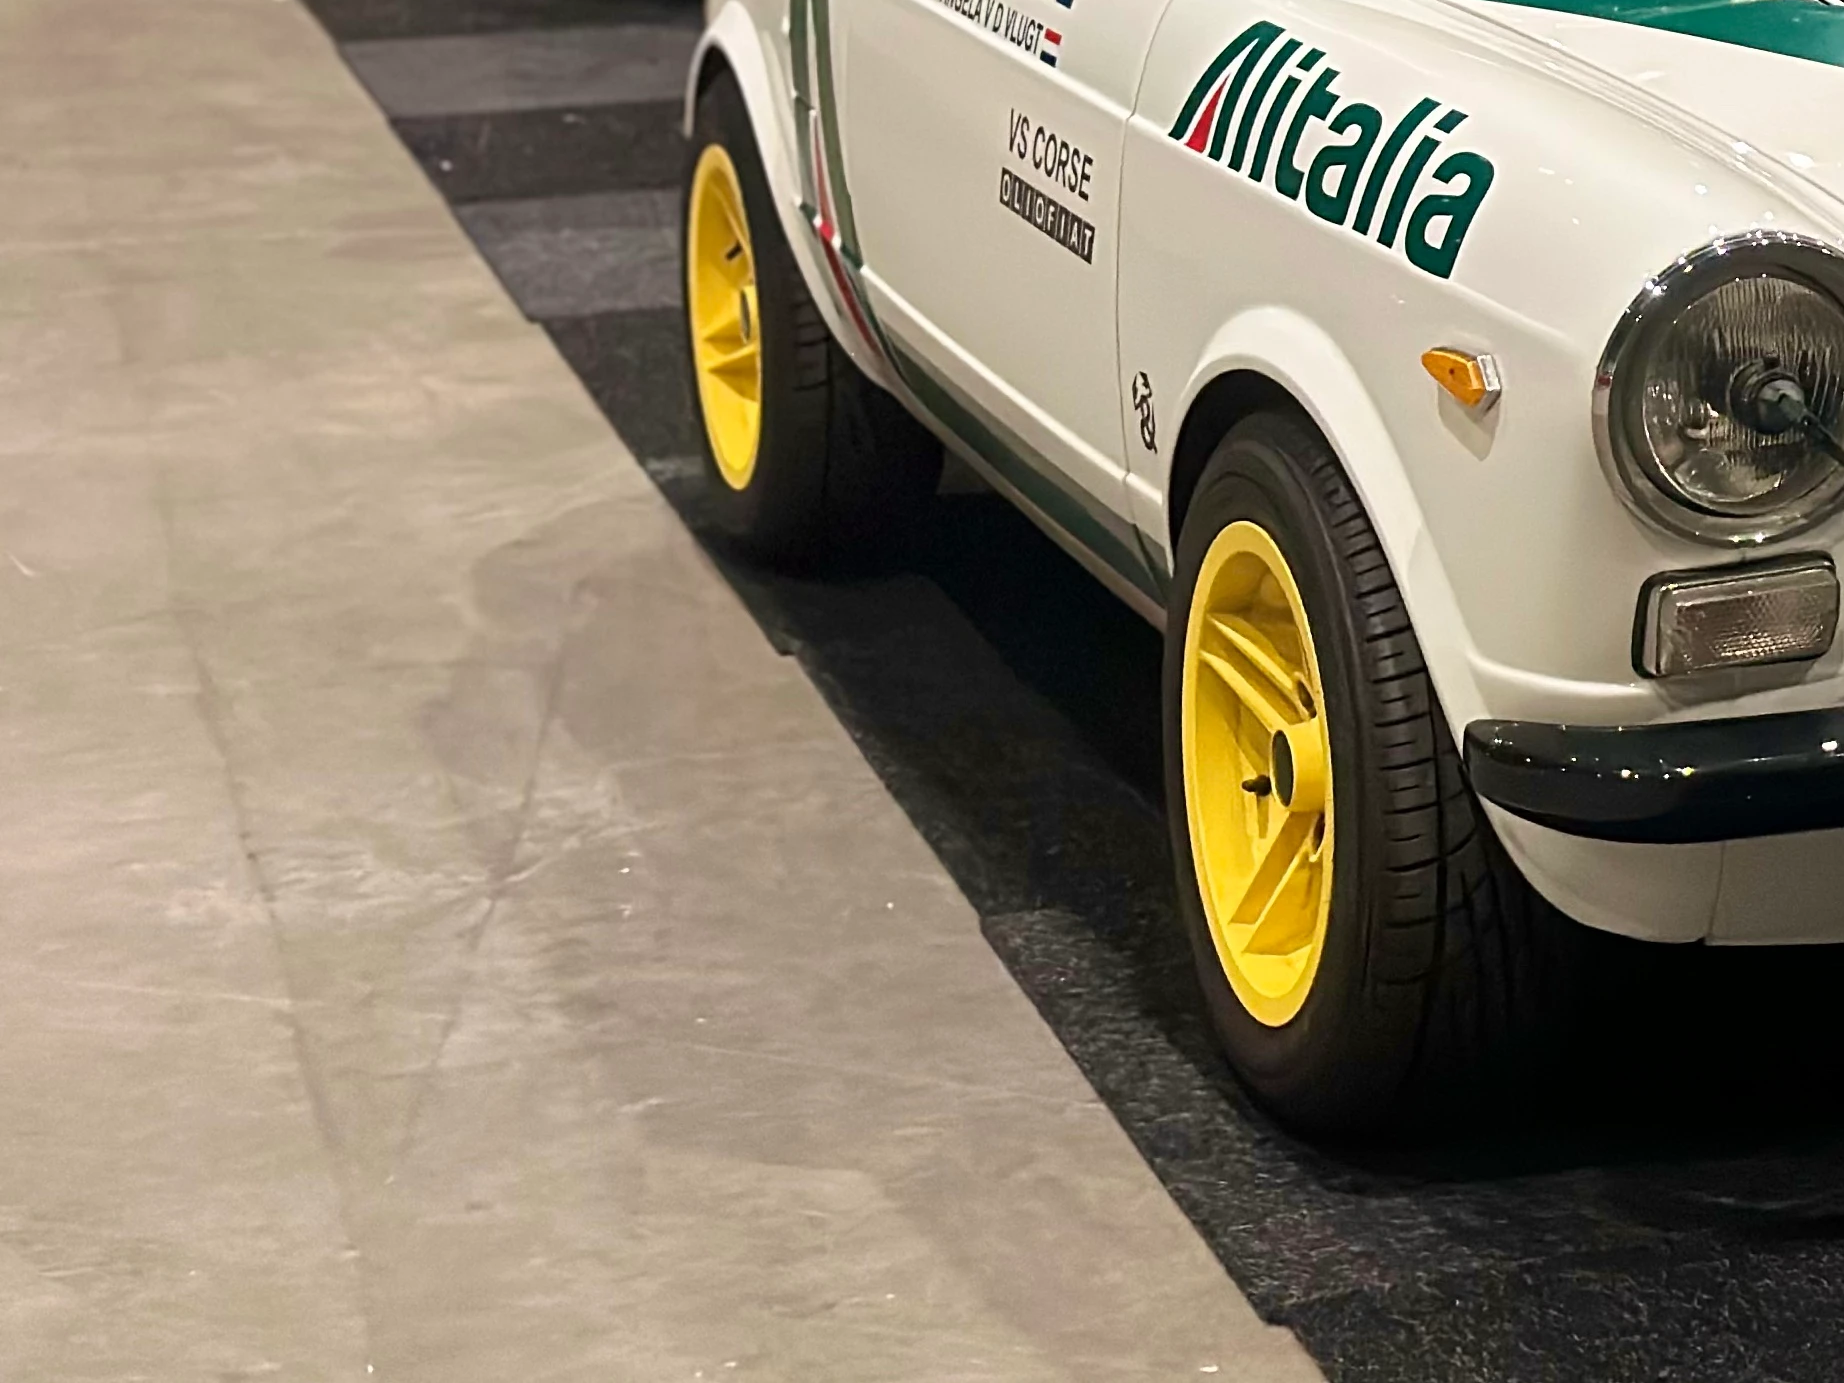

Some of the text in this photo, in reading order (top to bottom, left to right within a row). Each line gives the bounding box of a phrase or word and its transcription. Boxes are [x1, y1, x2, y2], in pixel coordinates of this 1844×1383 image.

[992, 2, 1005, 33] D
[1004, 6, 1044, 55] VLUGT
[1009, 107, 1094, 202] VS CORSE
[1168, 20, 1496, 280] Alitalia
